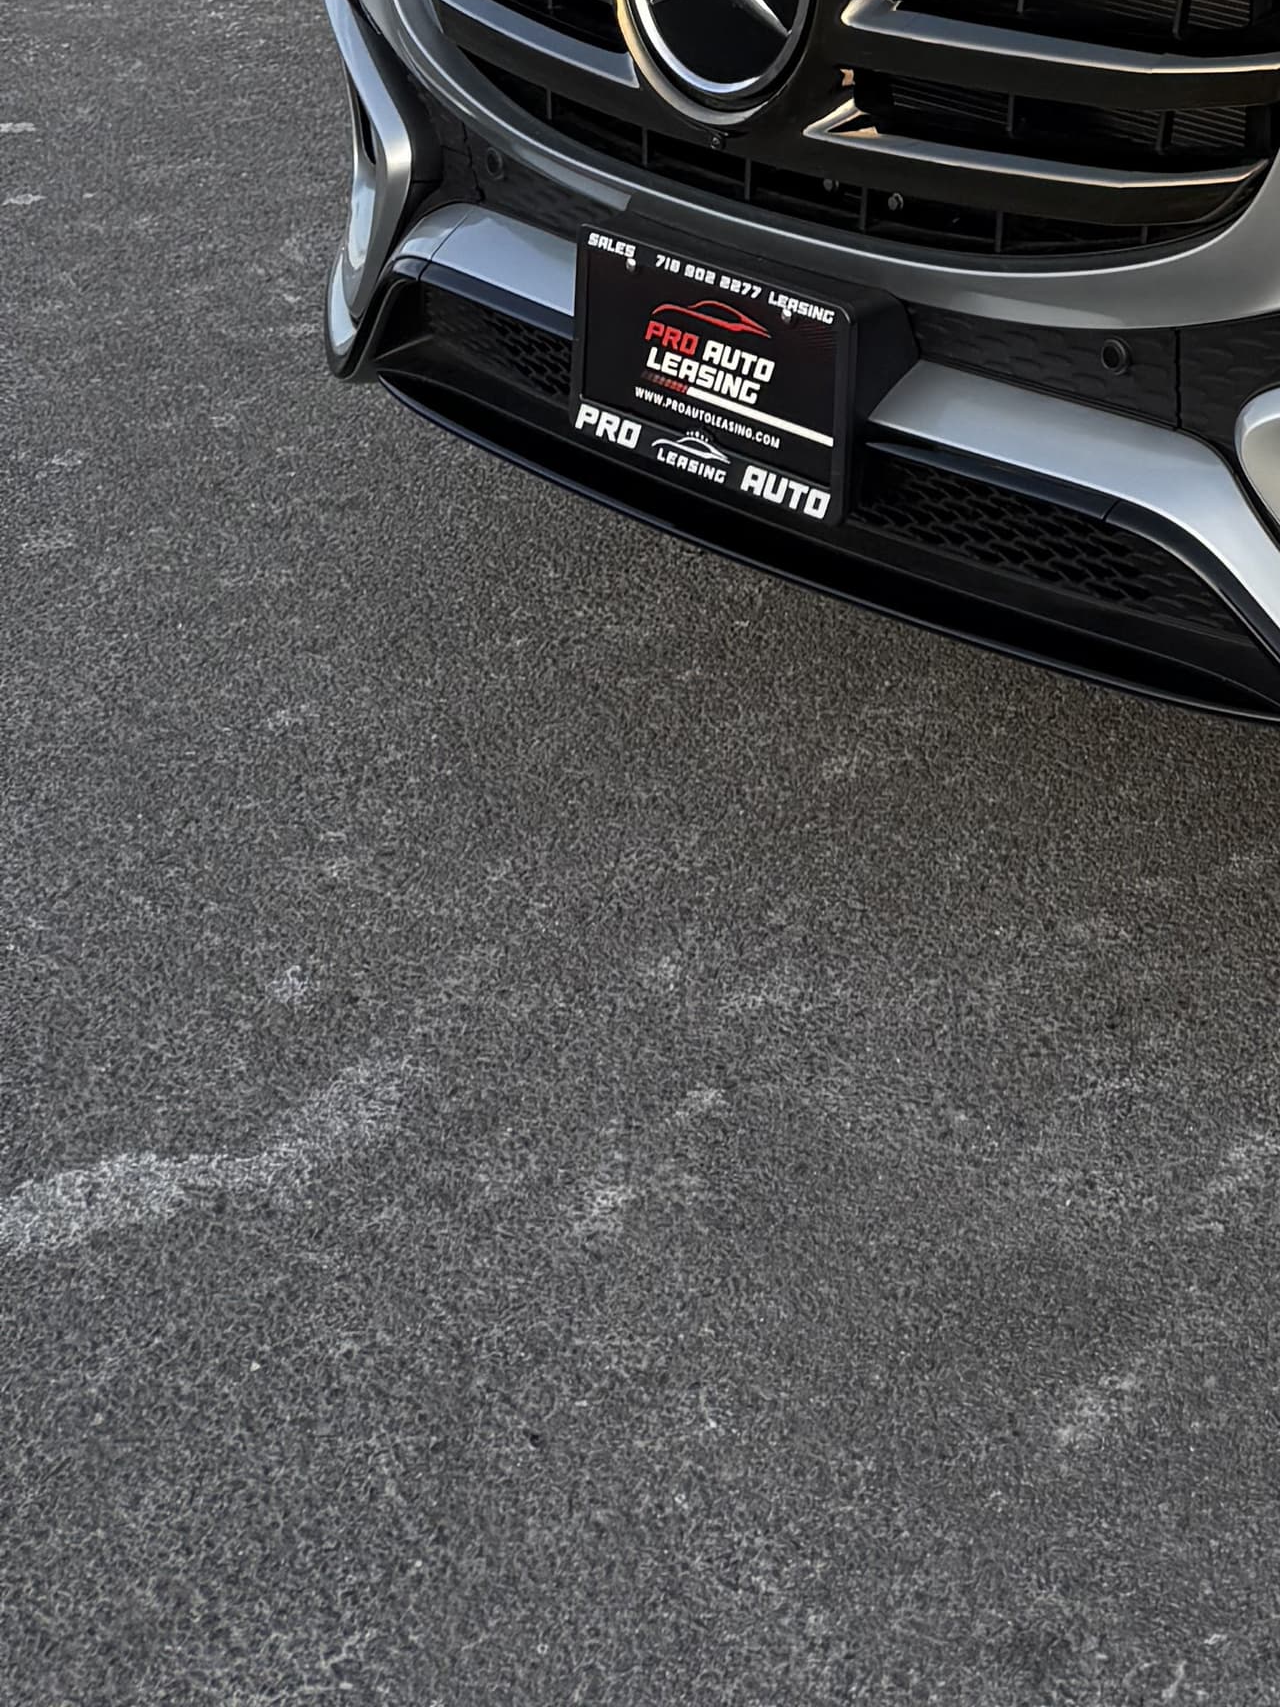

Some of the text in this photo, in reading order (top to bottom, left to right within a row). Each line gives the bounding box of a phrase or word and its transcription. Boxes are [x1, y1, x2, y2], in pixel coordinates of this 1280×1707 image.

[587, 232, 636, 259] SALES
[654, 253, 836, 325] 718 902 2277 LEASING
[644, 320, 776, 383] PRO AUTO
[645, 346, 761, 405] LEASING
[634, 386, 781, 449] WWW.PROAUTOLEASING.COM
[574, 403, 832, 520] PRO LEASING AUTO
